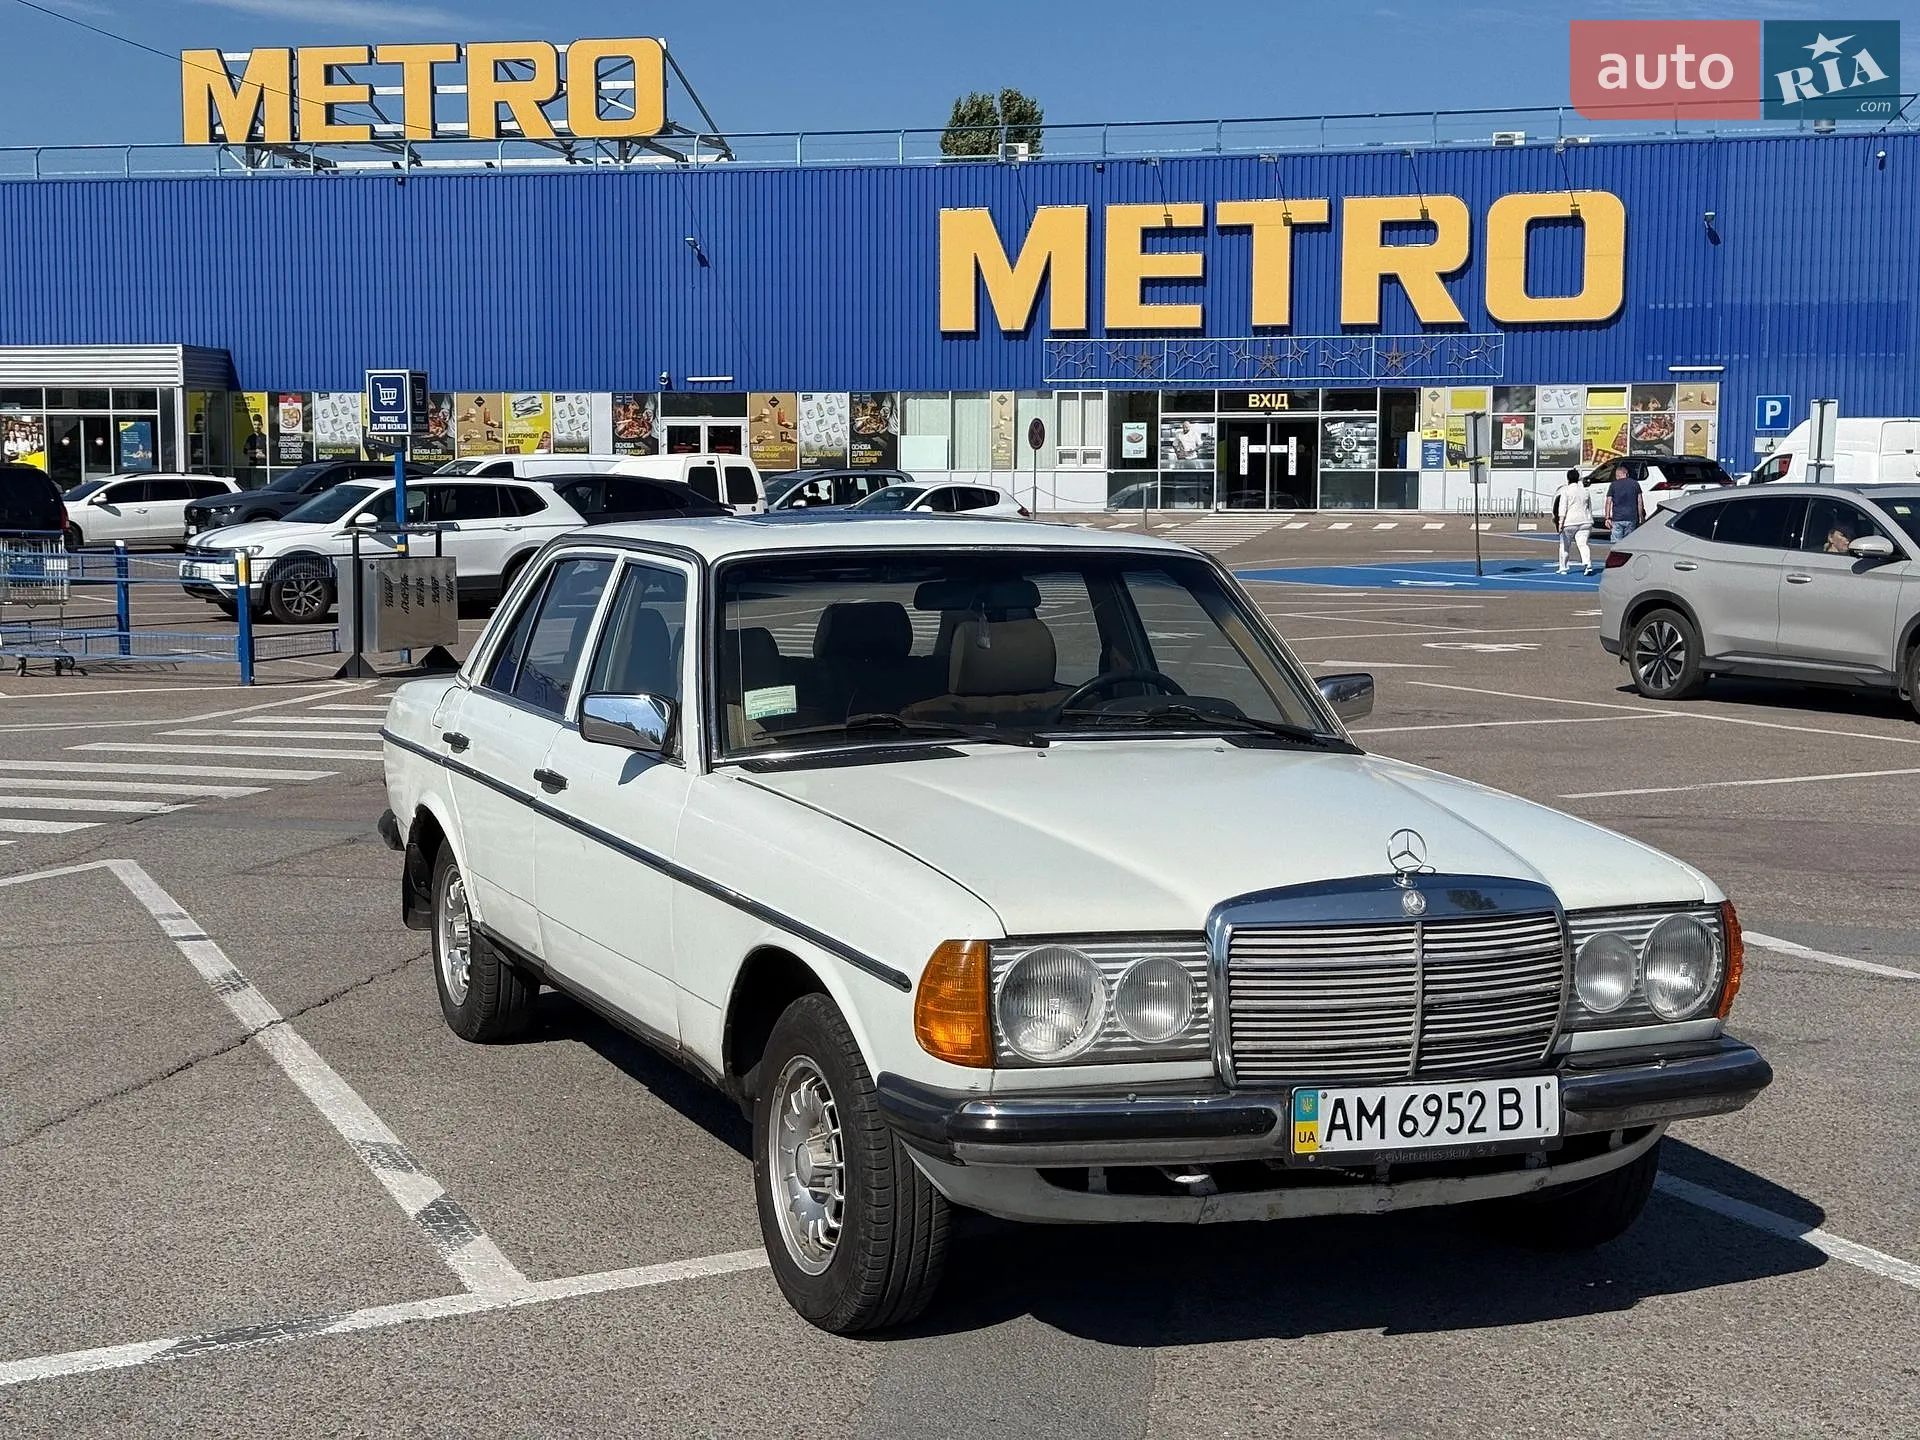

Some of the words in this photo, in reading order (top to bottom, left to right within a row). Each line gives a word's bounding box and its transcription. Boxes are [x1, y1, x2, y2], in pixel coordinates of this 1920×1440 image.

[180, 36, 667, 145] METRO
[938, 188, 1627, 332] METRO
[1248, 393, 1289, 410] ВХІД
[1765, 400, 1782, 425] P
[1325, 1095, 1386, 1142] AM
[1398, 1090, 1487, 1138] 6952
[1298, 1130, 1316, 1144] UA
